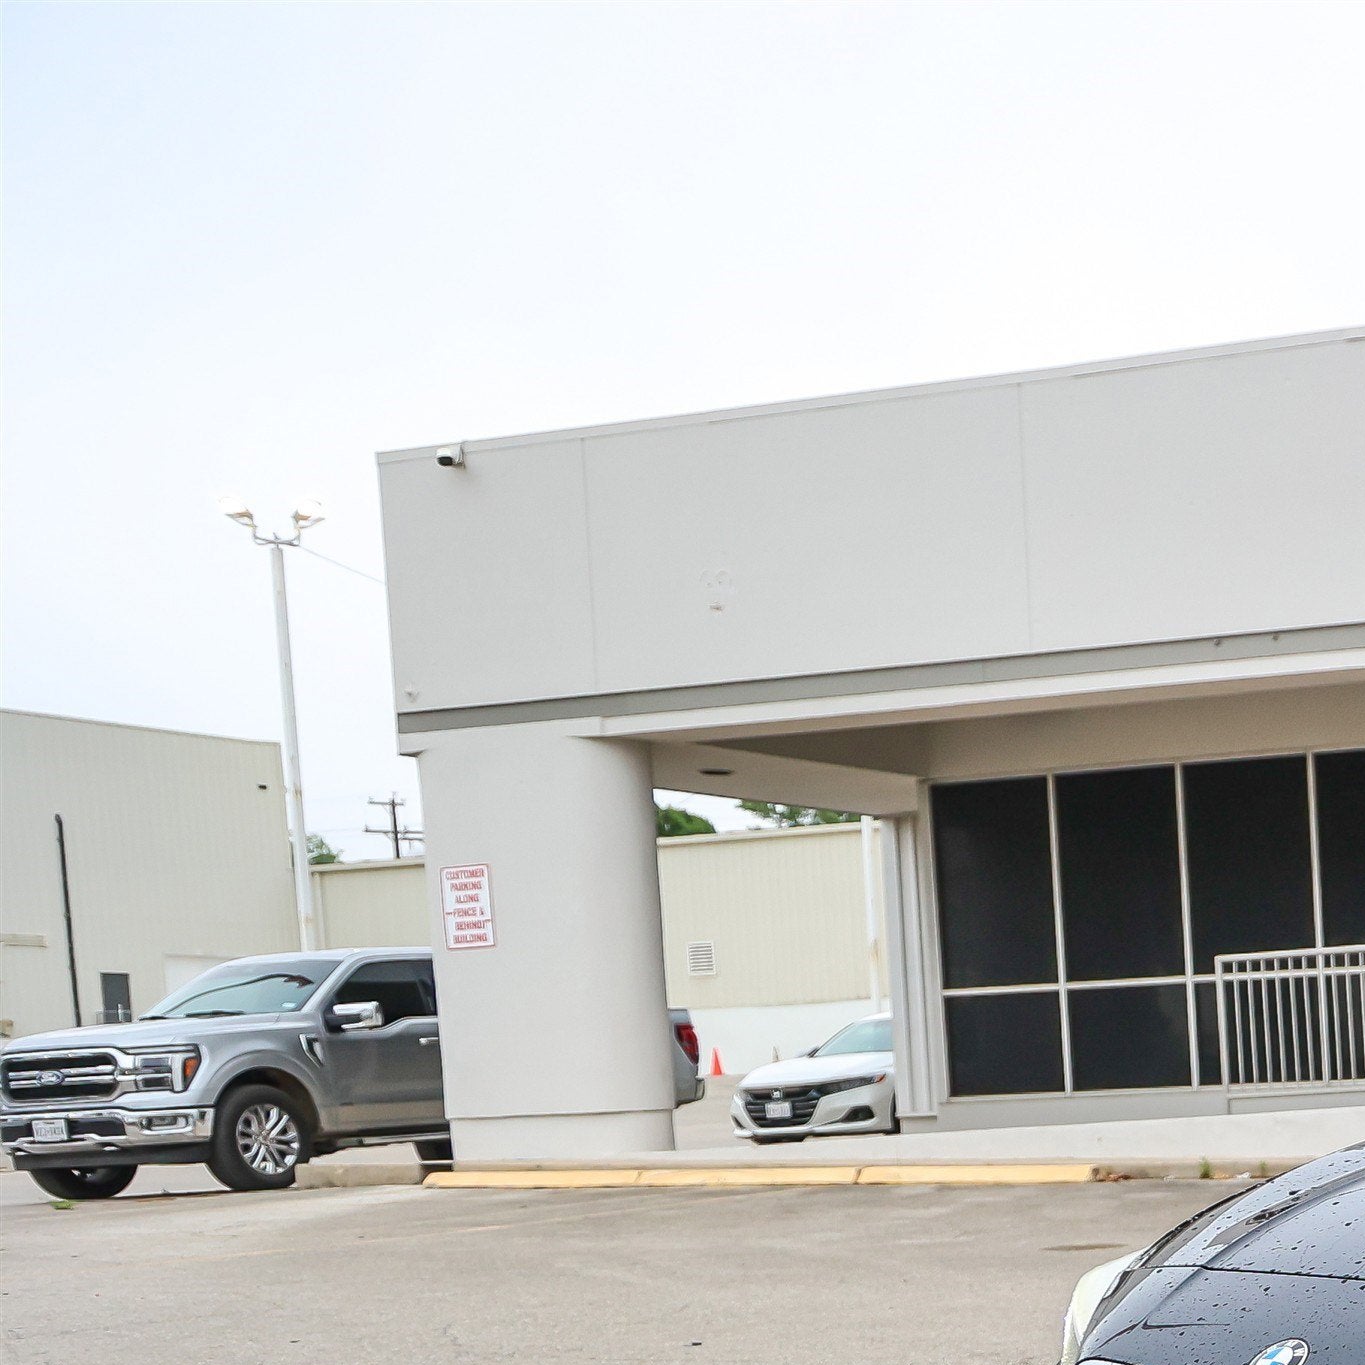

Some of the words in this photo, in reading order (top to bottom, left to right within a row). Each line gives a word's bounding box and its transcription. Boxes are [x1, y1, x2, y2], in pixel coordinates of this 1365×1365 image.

[445, 868, 484, 880] CUSTOMER
[450, 881, 482, 892] PARKING
[455, 893, 480, 903] ALONG
[453, 907, 477, 919] FENCE
[455, 920, 485, 931] BEHIND
[453, 933, 487, 945] BUILDING
